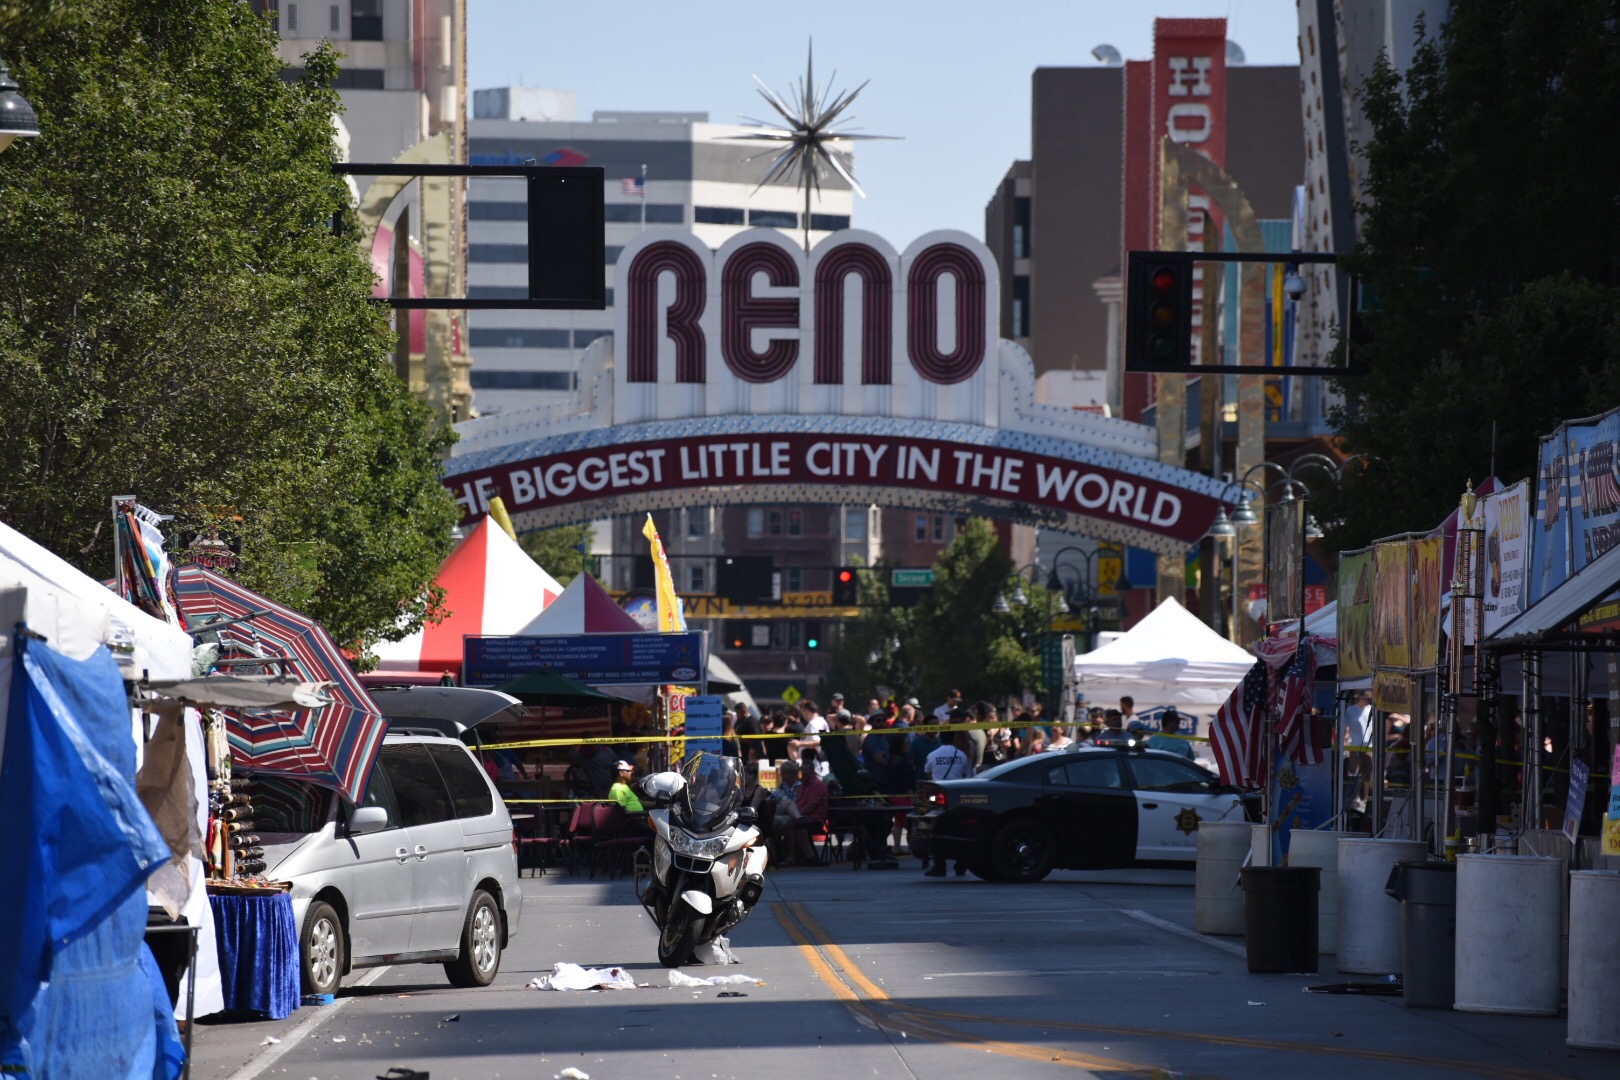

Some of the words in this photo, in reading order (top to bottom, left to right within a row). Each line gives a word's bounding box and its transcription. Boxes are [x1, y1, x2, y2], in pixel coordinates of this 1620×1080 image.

[627, 240, 986, 384] RENO
[448, 477, 492, 516] HE
[509, 449, 665, 505] BIGGEST
[680, 442, 790, 480] LITTLE
[805, 442, 889, 477] CITY
[896, 445, 940, 482] IN
[953, 450, 1024, 493] THE
[1036, 463, 1182, 528] WORLD
[936, 756, 962, 766] SECURTY
